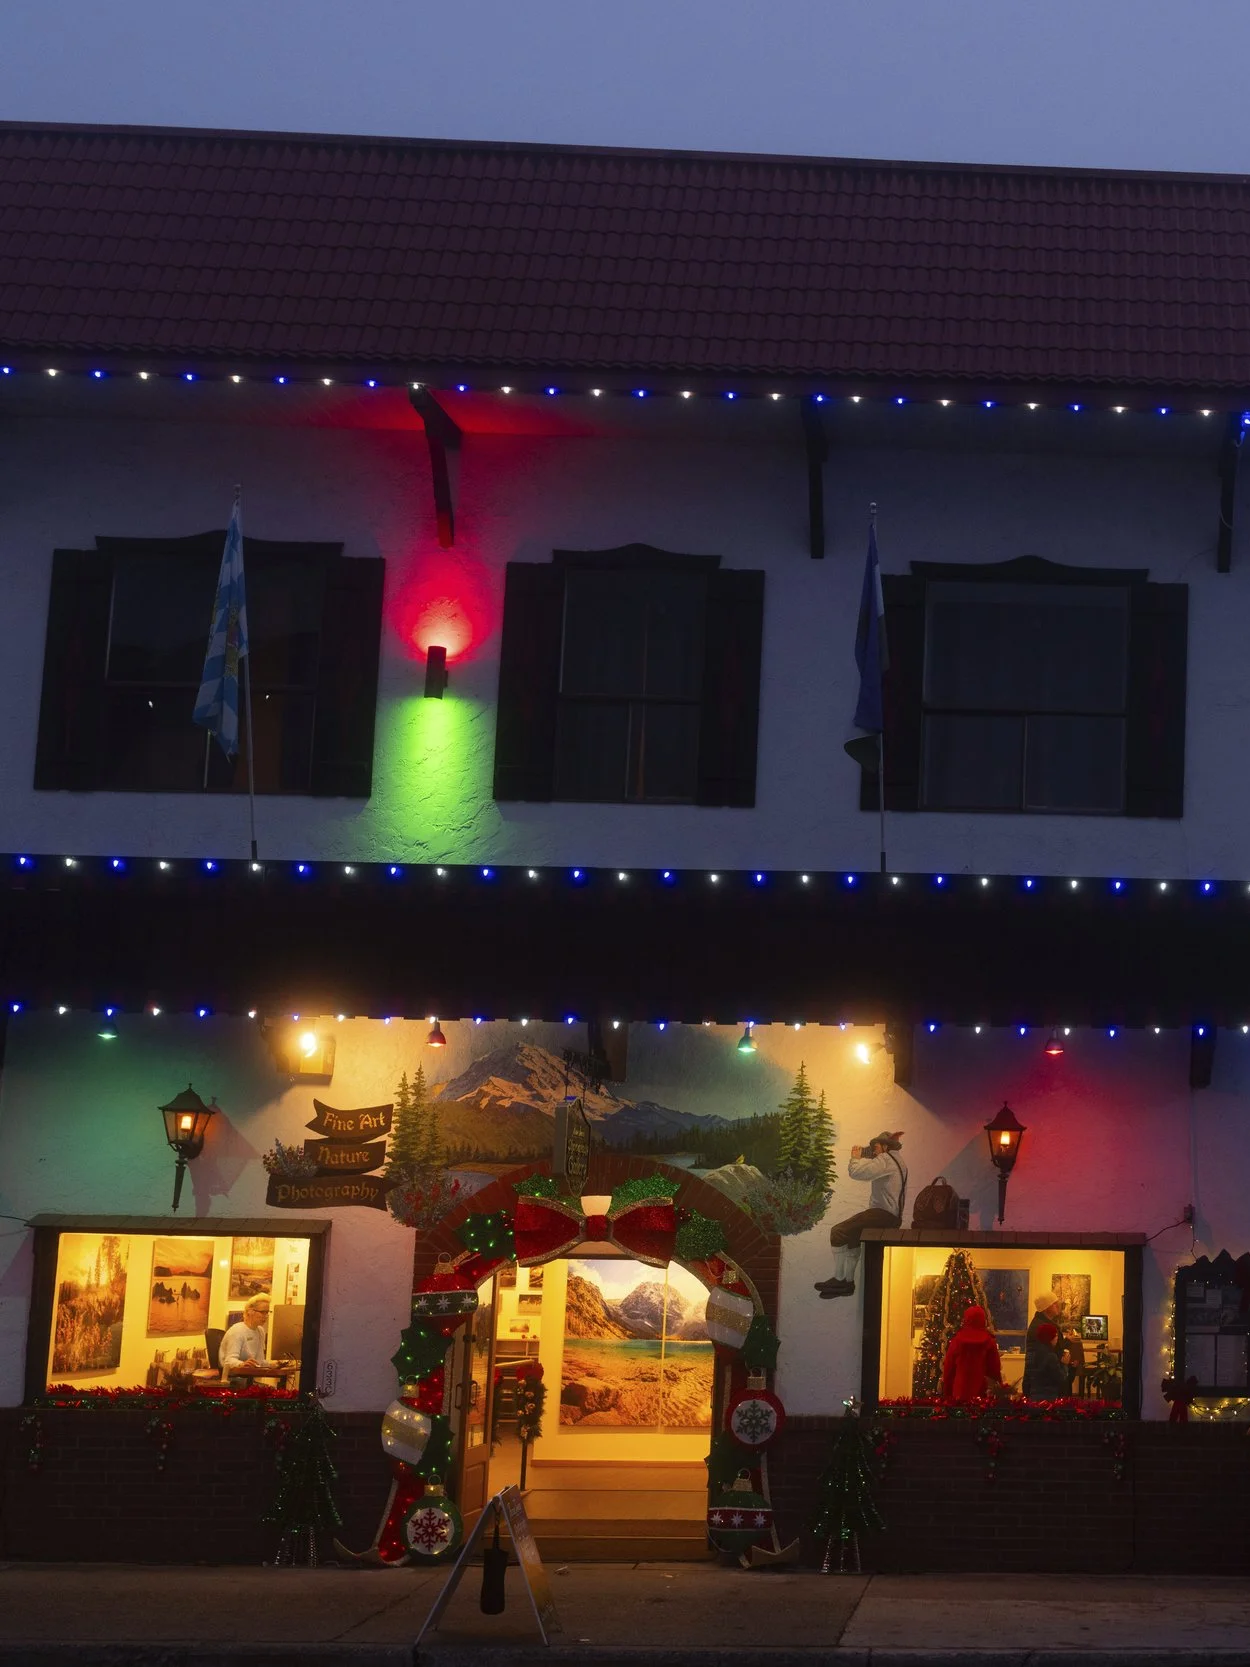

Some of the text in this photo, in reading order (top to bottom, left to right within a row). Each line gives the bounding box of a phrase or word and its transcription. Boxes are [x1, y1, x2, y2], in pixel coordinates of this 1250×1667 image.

[323, 1111, 386, 1131] Fine Art
[318, 1145, 370, 1165] Nature
[275, 1182, 379, 1202] Photography
